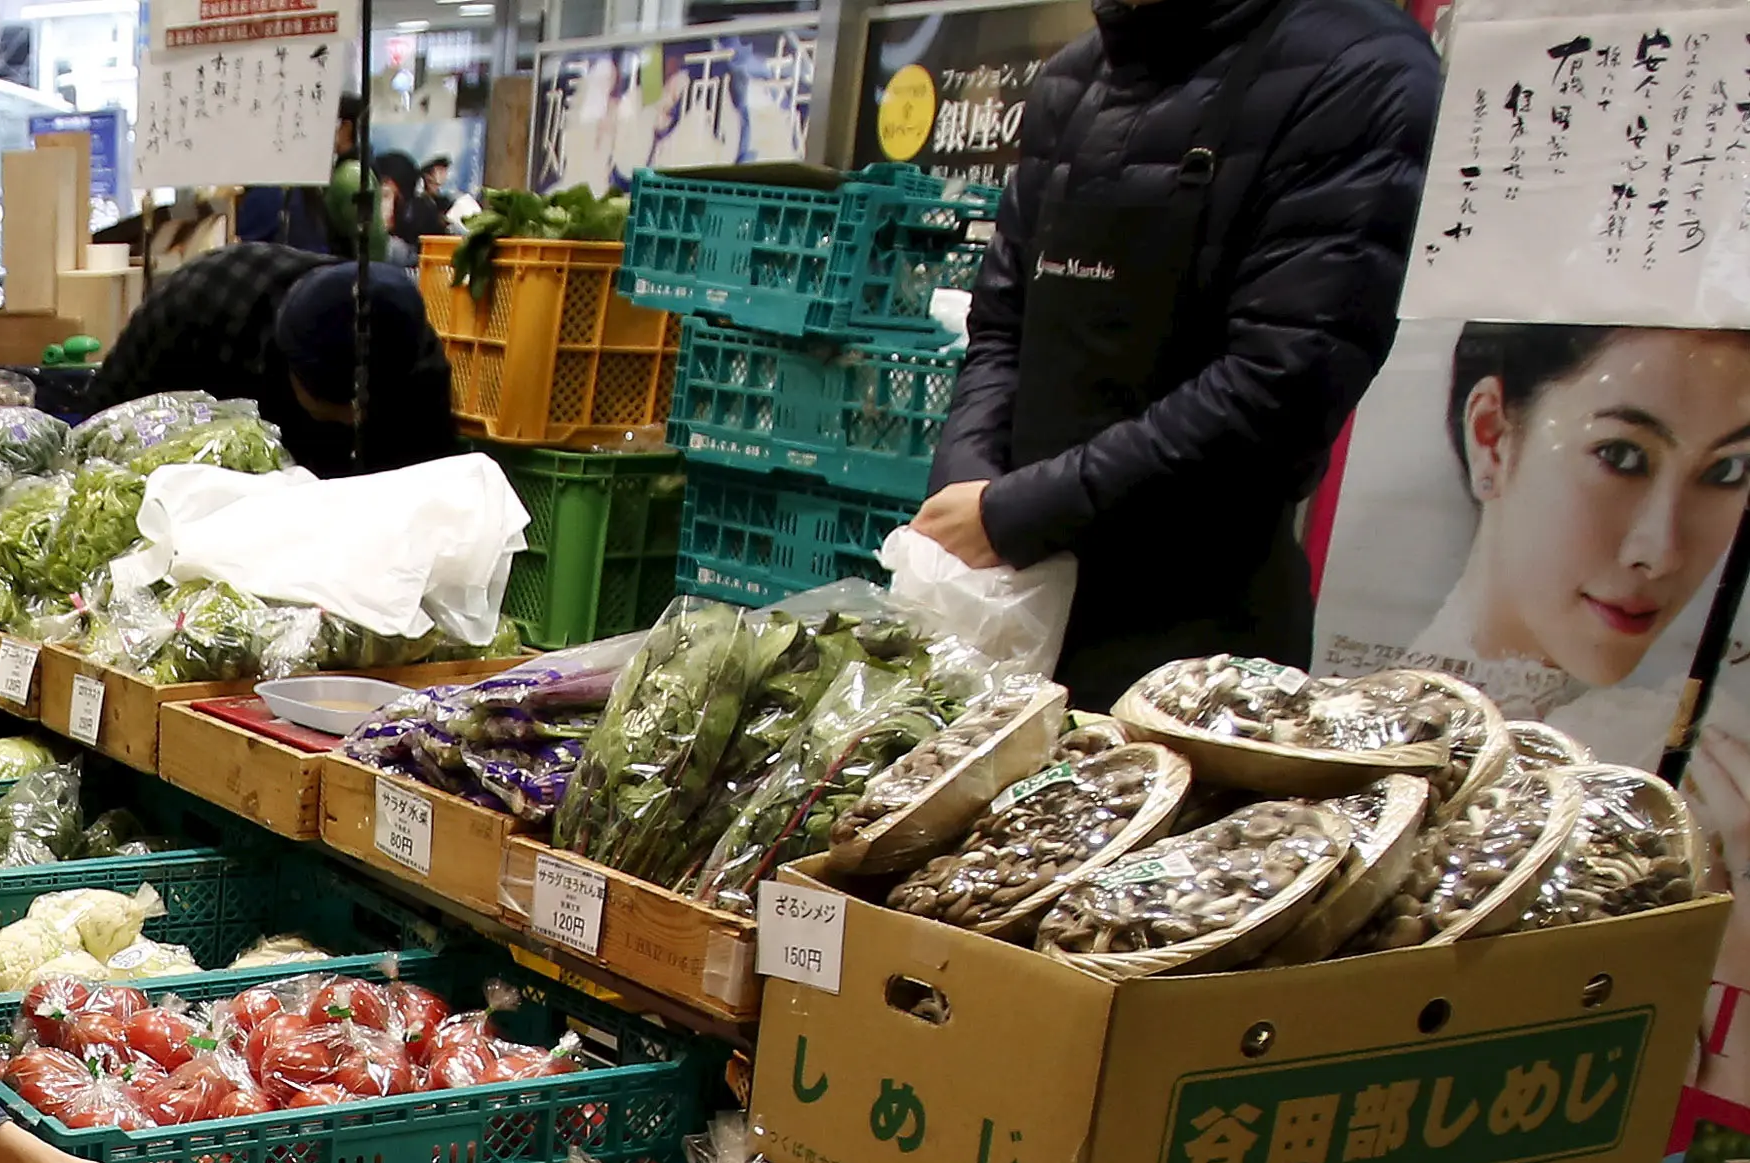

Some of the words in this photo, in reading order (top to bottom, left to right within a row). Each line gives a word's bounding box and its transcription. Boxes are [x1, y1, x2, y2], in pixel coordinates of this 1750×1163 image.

[942, 57, 1047, 90] ファッション、グ
[932, 97, 1026, 155] 銀座の
[389, 831, 414, 857] 80円
[774, 895, 837, 924] ざるシメジ
[552, 911, 587, 939] 120円
[783, 946, 823, 973] 150円
